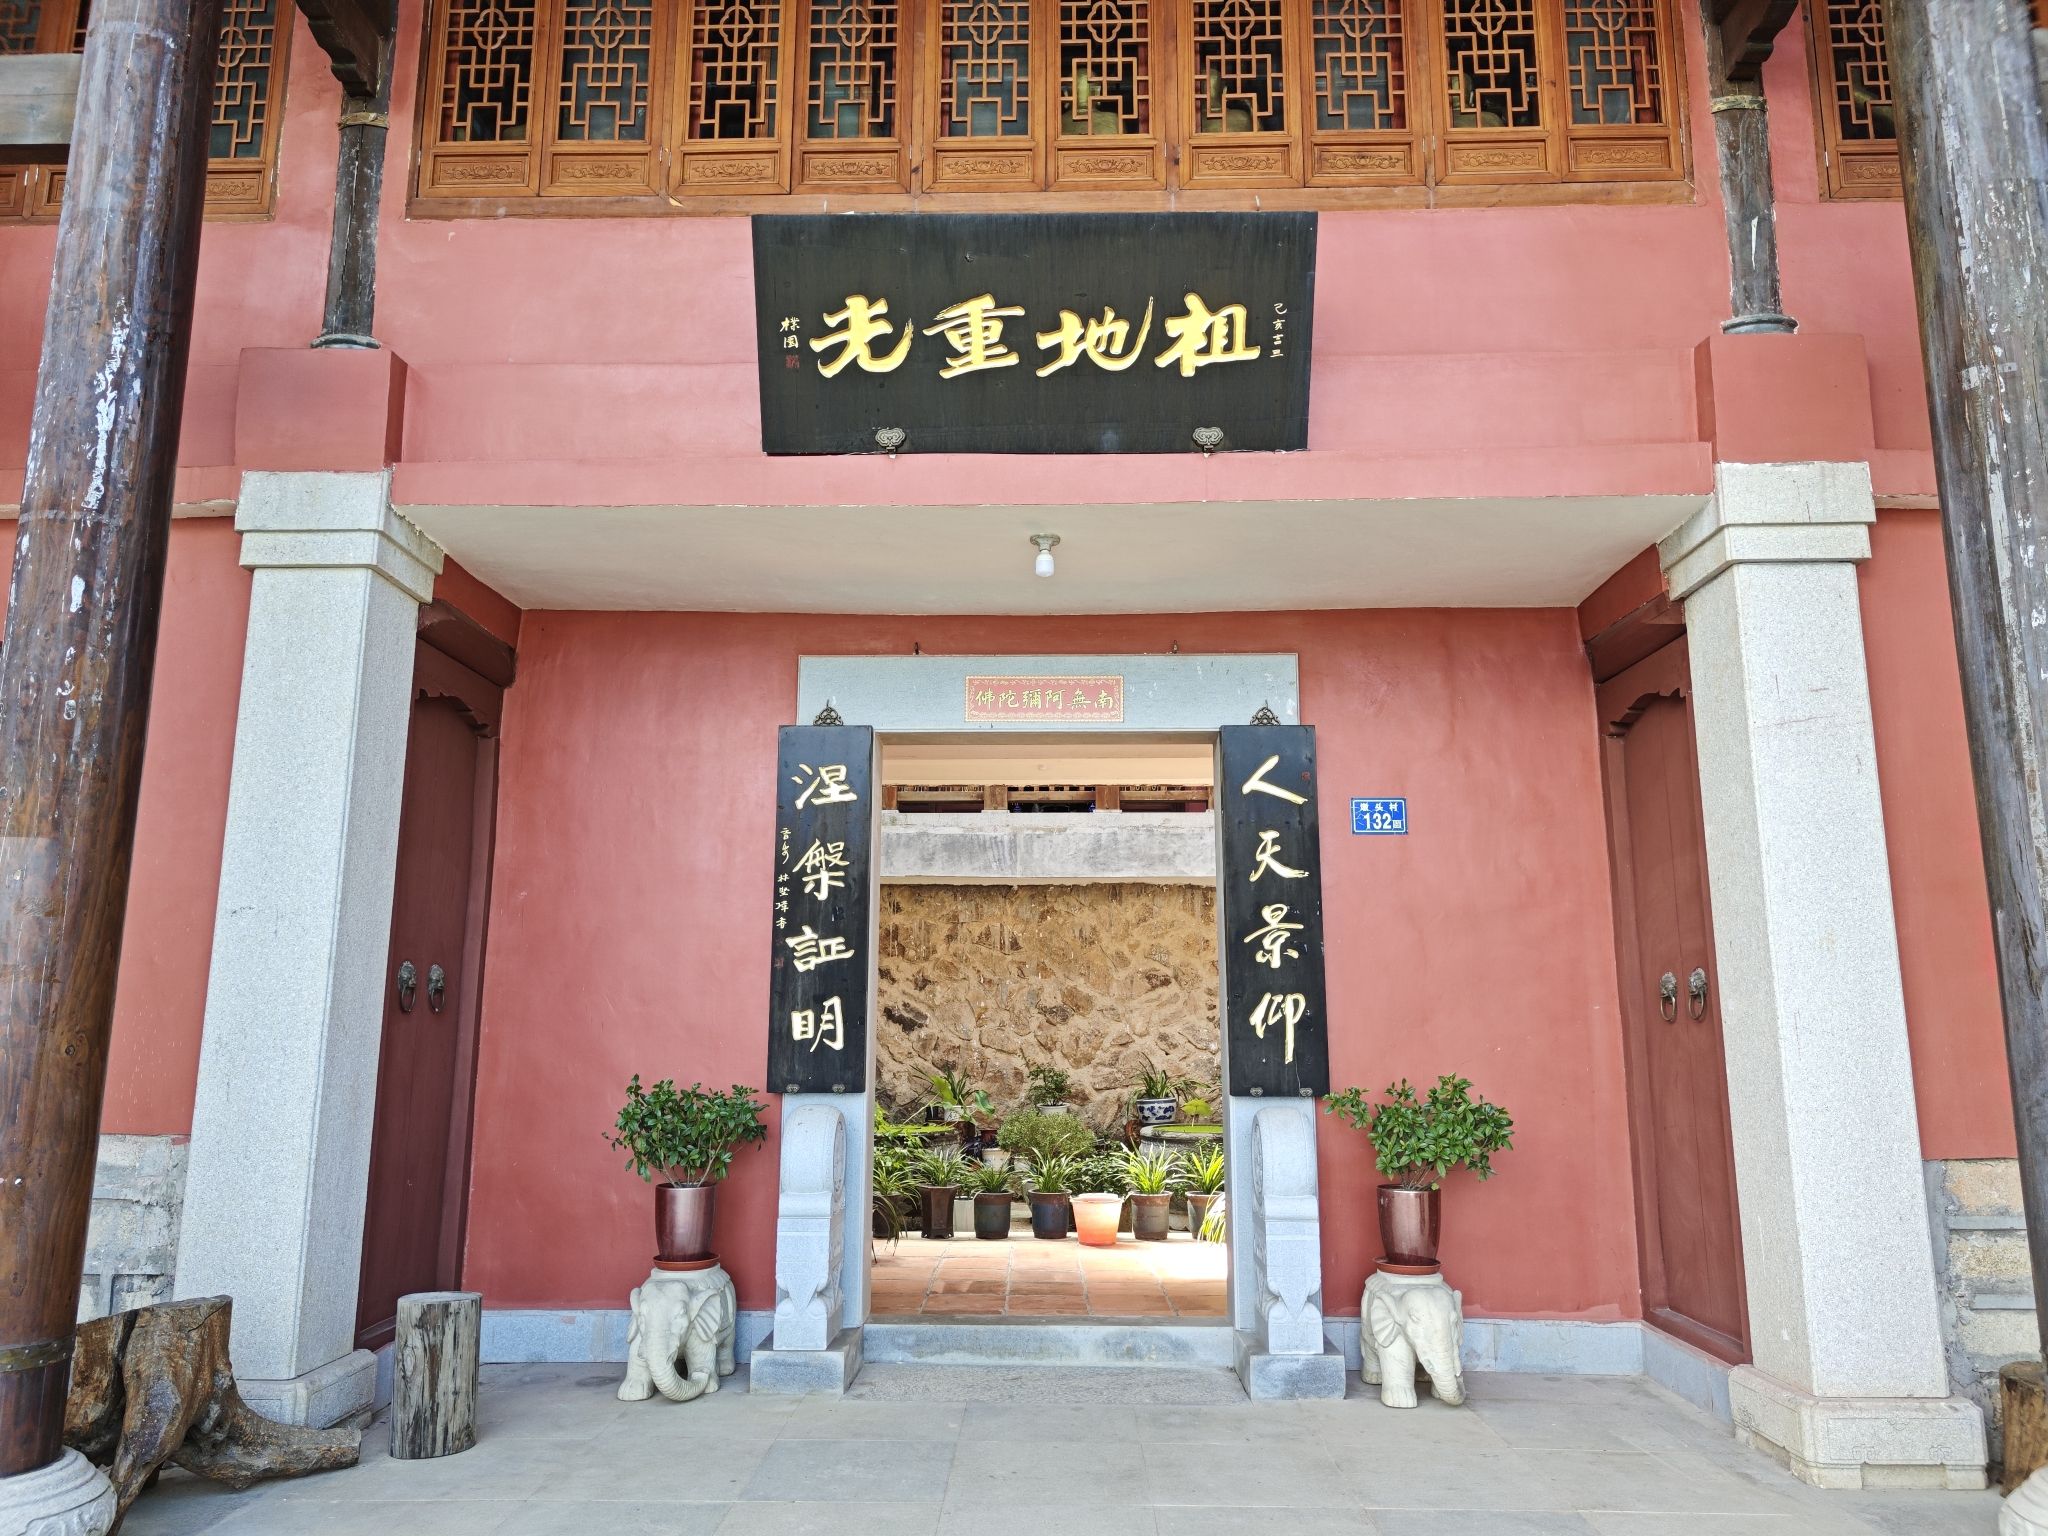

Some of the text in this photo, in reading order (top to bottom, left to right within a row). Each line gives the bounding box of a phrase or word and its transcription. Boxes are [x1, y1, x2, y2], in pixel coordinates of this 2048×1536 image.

[809, 292, 1262, 379] 祖地重光
[1270, 302, 1287, 358] 己亥吉旦
[975, 687, 1114, 710] 南無阿彌陀佛
[1363, 812, 1392, 830] 132
[784, 763, 858, 1053] 涅槃証明
[1242, 755, 1310, 1064] 人天景仰
